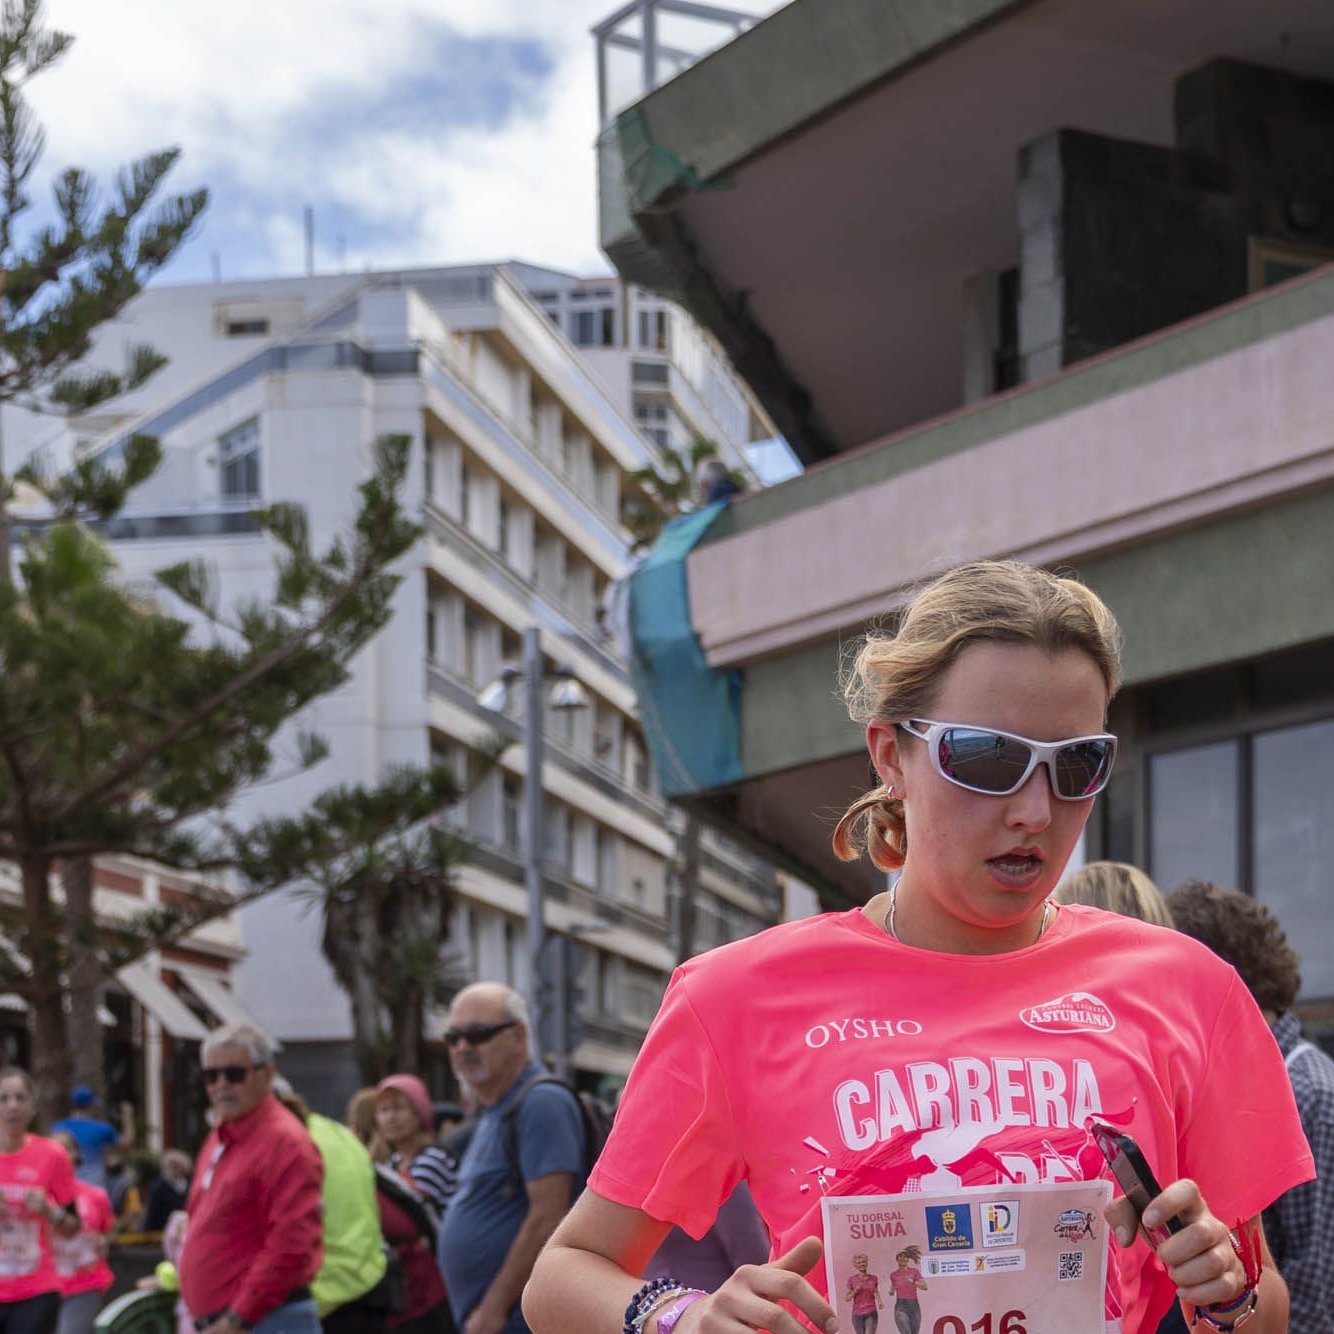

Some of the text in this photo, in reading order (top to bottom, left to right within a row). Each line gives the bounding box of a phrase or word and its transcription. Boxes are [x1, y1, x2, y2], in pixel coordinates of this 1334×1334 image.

[1029, 1008, 1110, 1028] ASTURIANA
[805, 1018, 923, 1048] OYSHO
[833, 1056, 1103, 1152] CARRERA
[847, 1211, 905, 1224] TU DORSAL
[850, 1224, 908, 1241] SUMA
